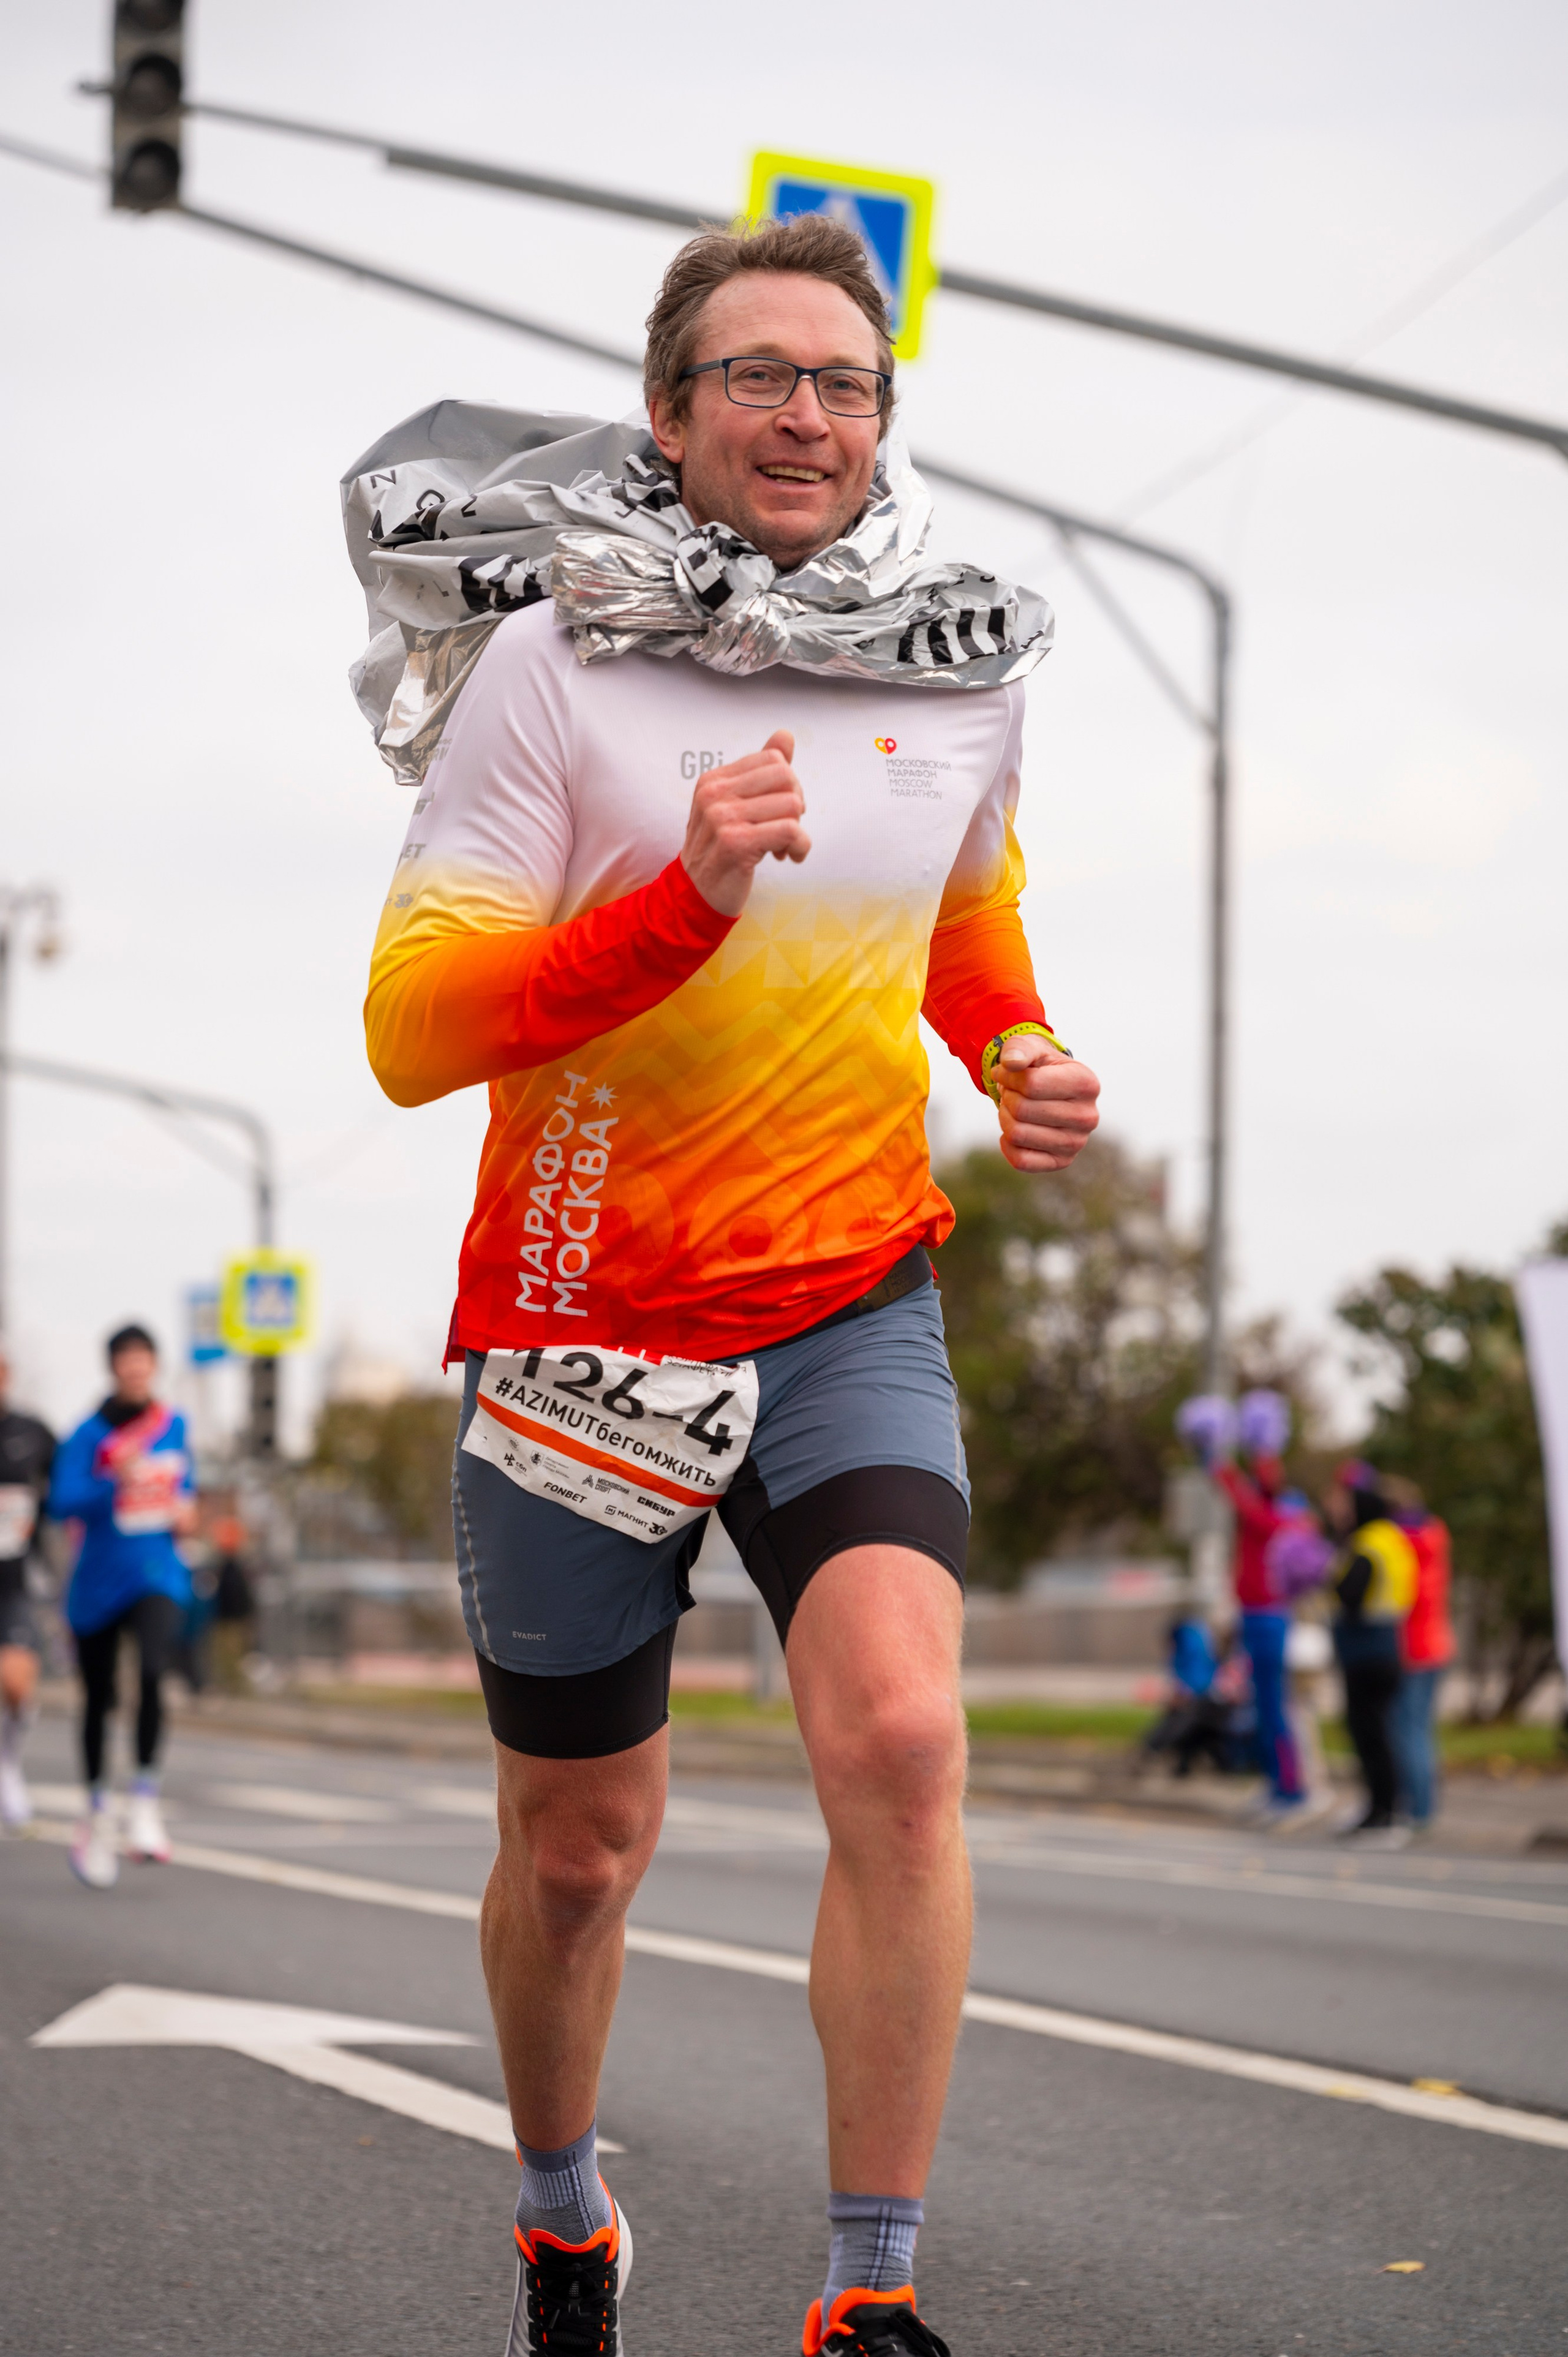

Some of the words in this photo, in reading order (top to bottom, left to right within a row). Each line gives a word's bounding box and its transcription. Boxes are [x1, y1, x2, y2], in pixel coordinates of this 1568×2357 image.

[886, 759, 951, 771] МОСКОВСКИЙ
[888, 769, 937, 779] МАРАФОН
[889, 779, 932, 788] MOSCOW
[891, 788, 942, 800] MARATHON
[515, 1070, 588, 1313] МАРАФОН
[552, 1117, 619, 1317] МОСКВА
[495, 1376, 717, 1487] #AZIMUTбегомЖИТЬ
[543, 1481, 587, 1504] FONBET
[594, 1484, 612, 1495] СПОРТ
[597, 1477, 630, 1495] МОСКОВСКИЙ
[636, 1496, 676, 1517] СИБУР
[617, 1510, 649, 1529] МАГНИТ
[512, 1631, 547, 1641] EVADICT
